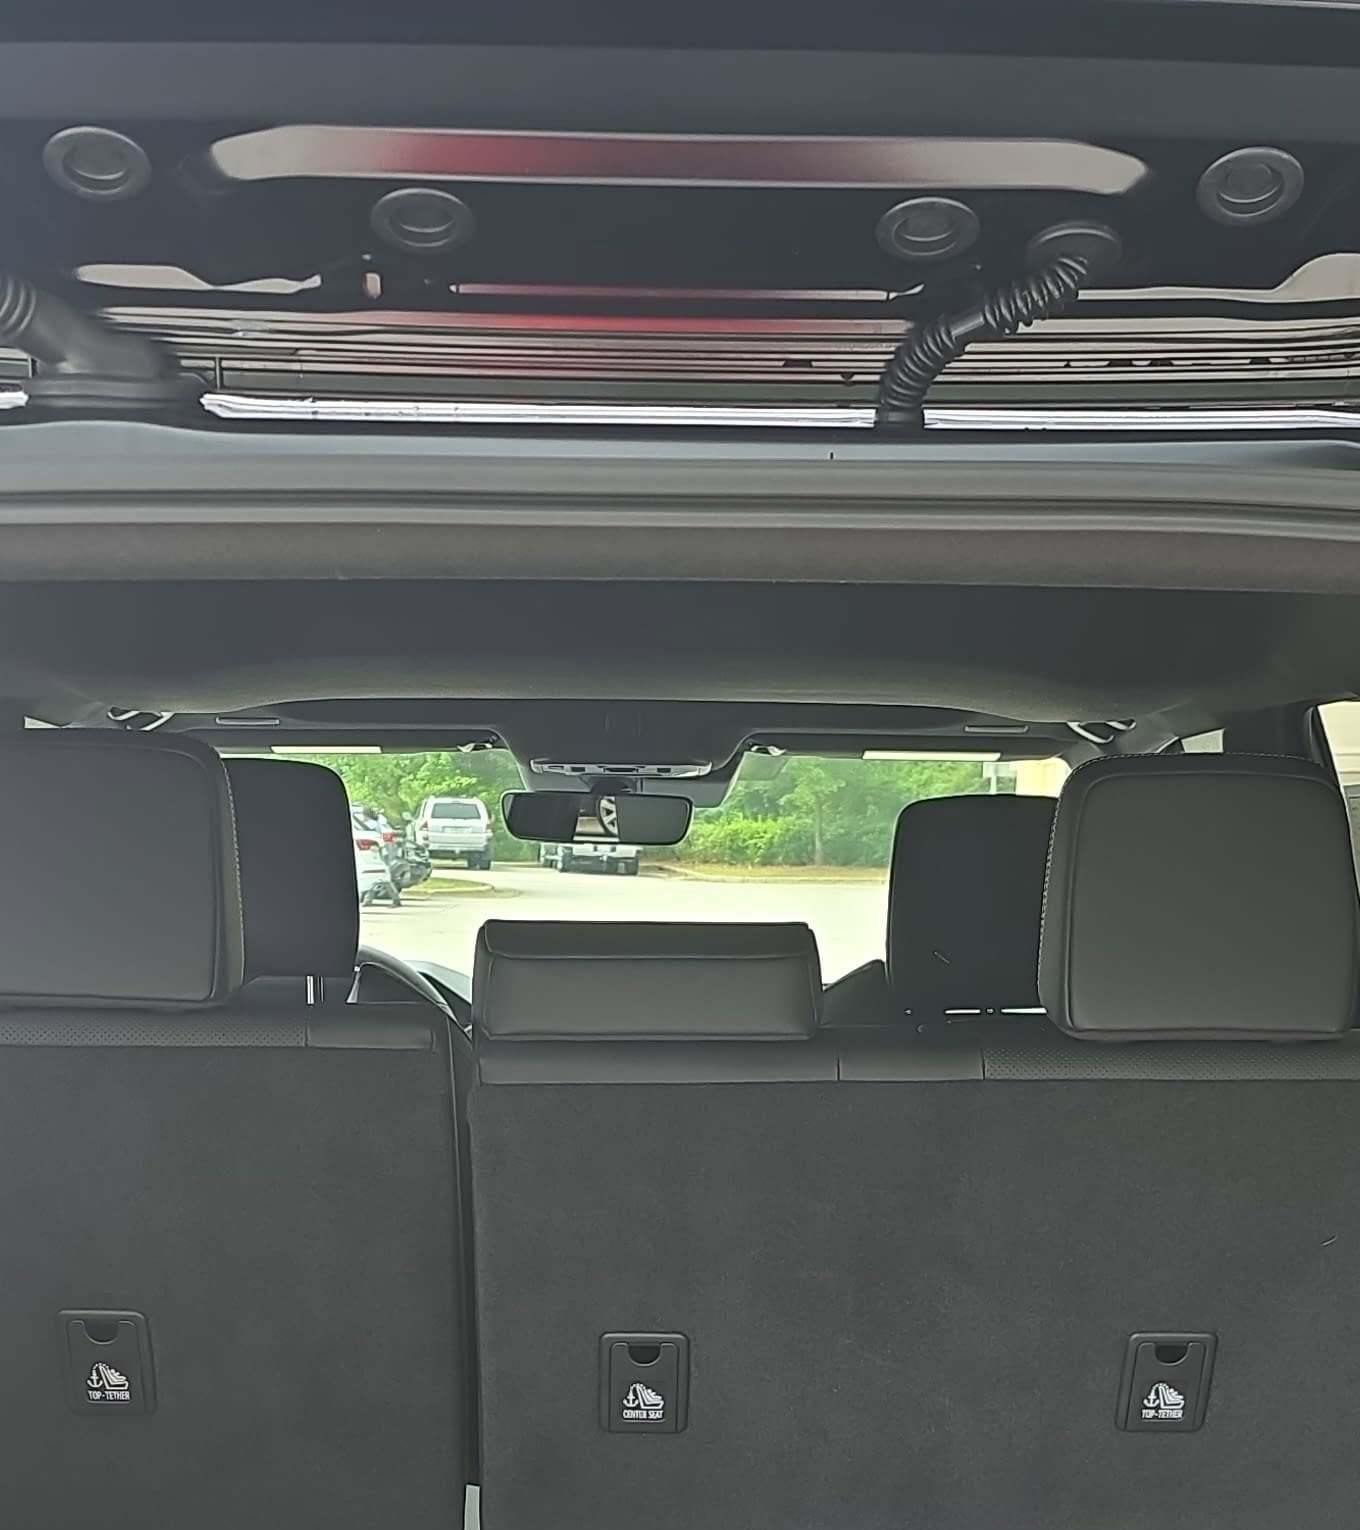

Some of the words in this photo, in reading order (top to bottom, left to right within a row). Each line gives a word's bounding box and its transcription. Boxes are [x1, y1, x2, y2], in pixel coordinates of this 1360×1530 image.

[87, 1390, 131, 1401] TOP-TETHER
[622, 1409, 647, 1419] CENTER
[648, 1409, 664, 1419] SEAT
